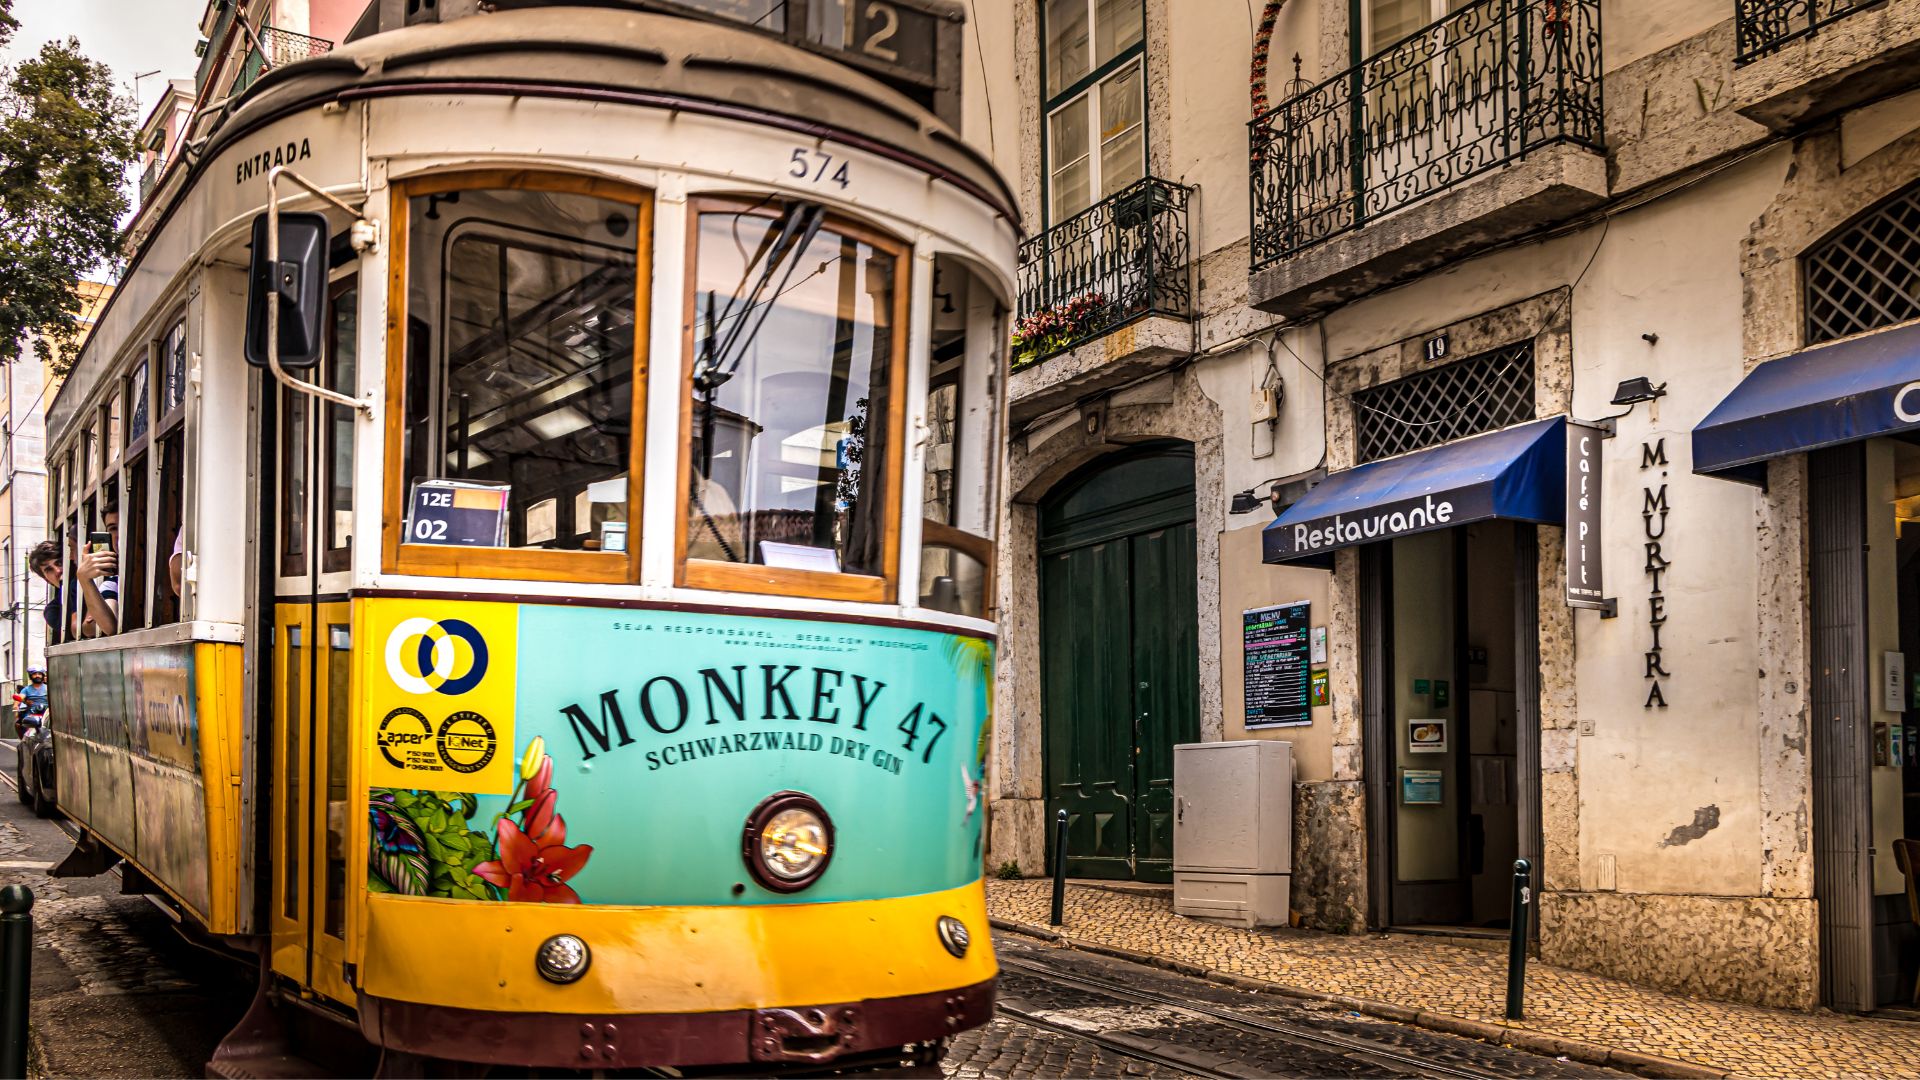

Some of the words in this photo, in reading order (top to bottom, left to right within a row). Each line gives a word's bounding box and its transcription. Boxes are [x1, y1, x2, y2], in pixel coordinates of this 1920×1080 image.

[236, 137, 311, 185] ENTRADA
[789, 148, 850, 190] 574
[1428, 337, 1445, 360] 19
[1579, 436, 1590, 511] Café
[420, 492, 452, 508] 12E
[415, 519, 448, 540] 02
[1294, 495, 1454, 552] Restaurante
[1260, 610, 1281, 622] MENU
[613, 622, 653, 631] SEJA
[664, 625, 773, 639] RESPONSÁVEL
[796, 633, 831, 642] BEBA
[838, 637, 863, 645] COM
[559, 663, 887, 761] MONKEY
[896, 701, 948, 764] 47
[387, 732, 423, 748] apcer
[448, 736, 484, 749] IQNet
[645, 731, 823, 771] SCHWARZWALD
[829, 736, 870, 762] DRY
[872, 749, 904, 776] GIN
